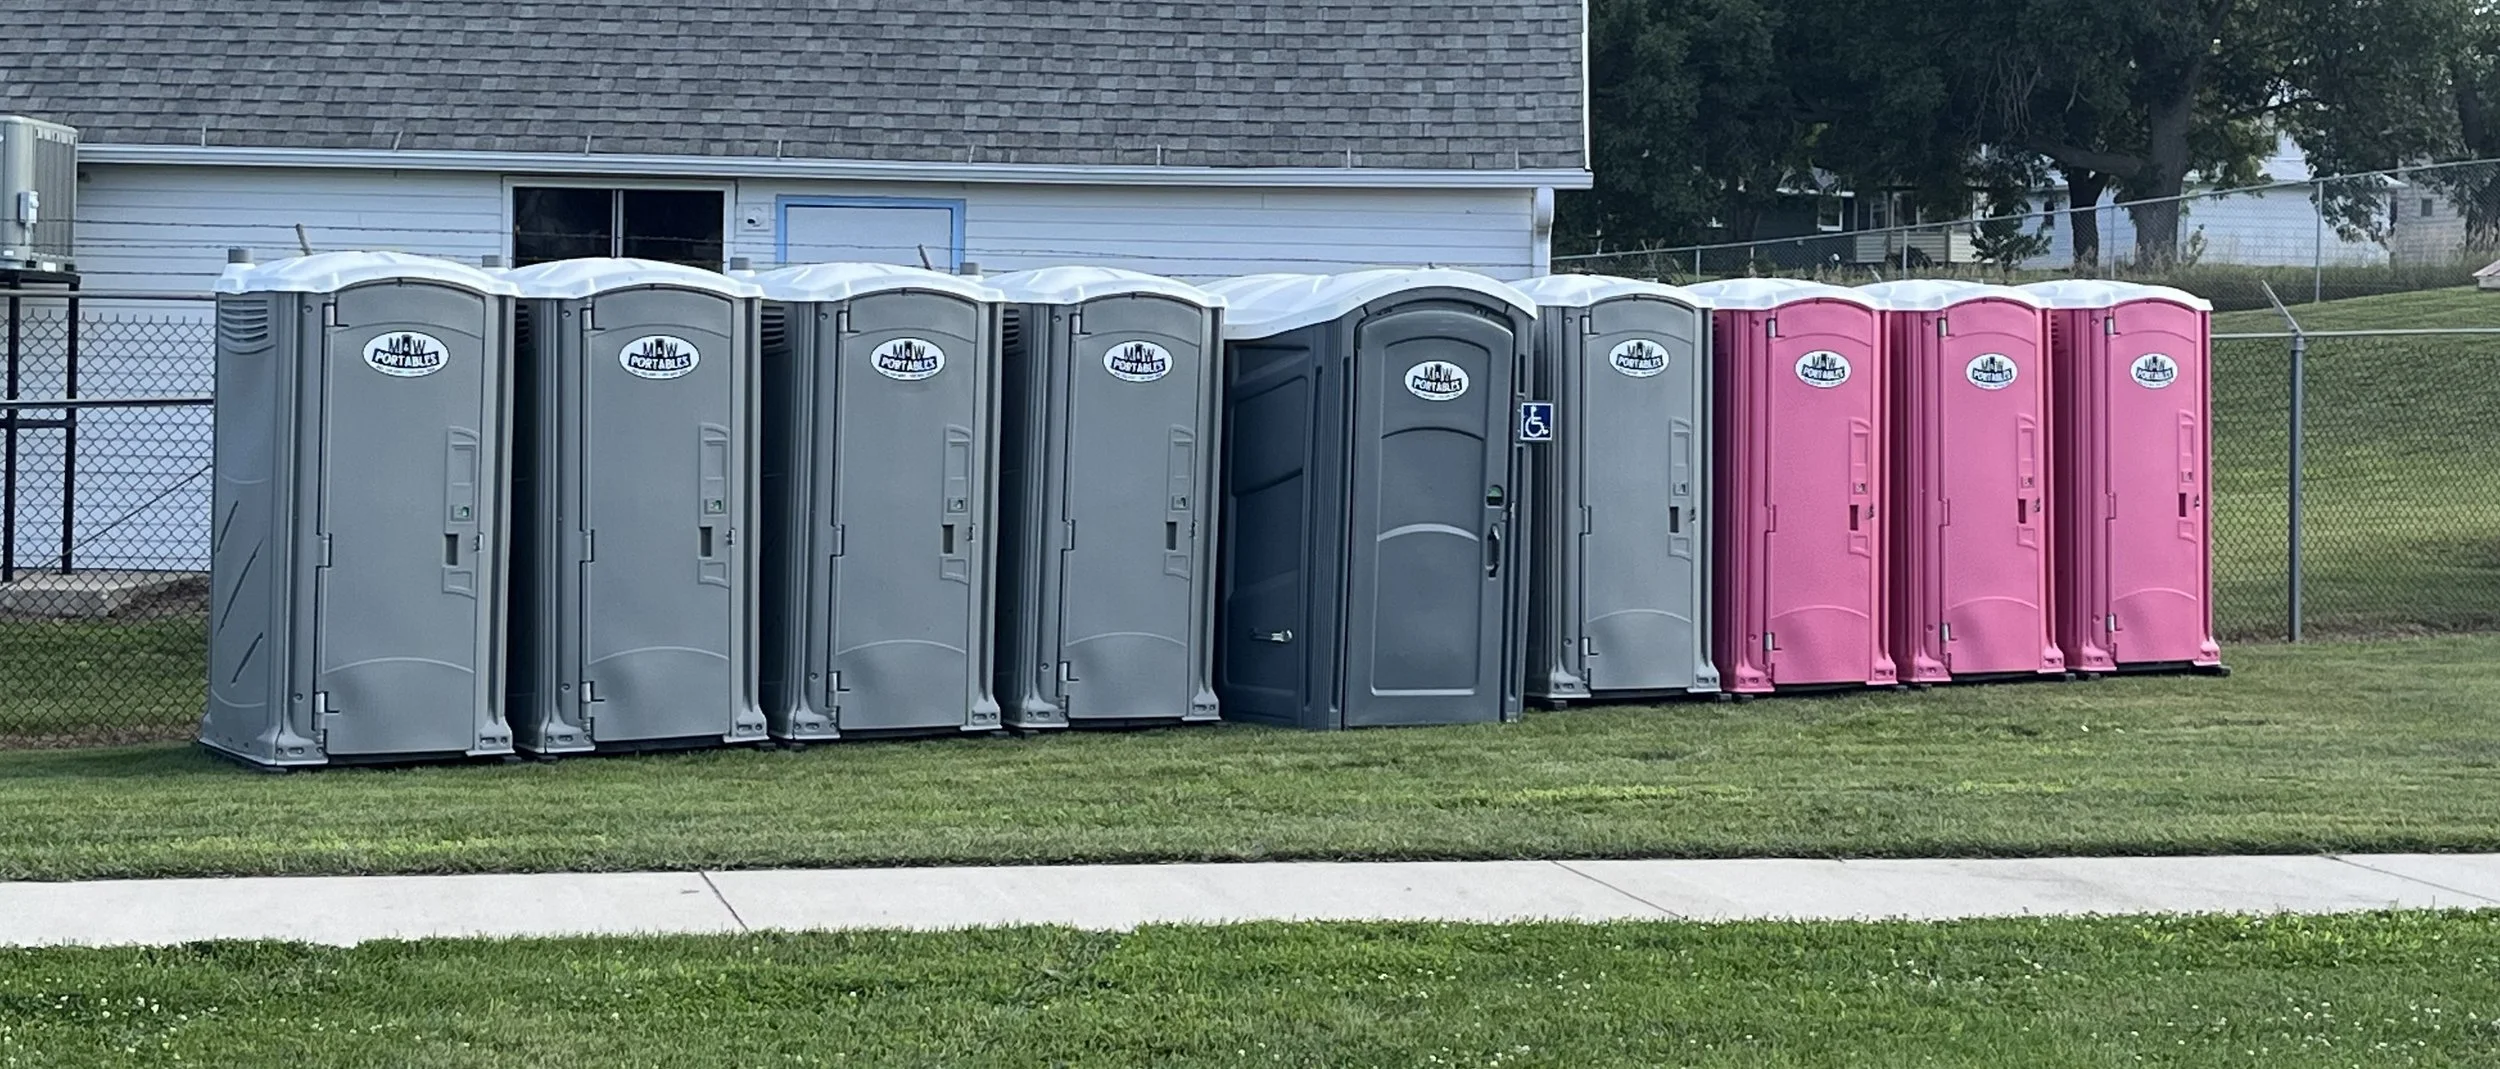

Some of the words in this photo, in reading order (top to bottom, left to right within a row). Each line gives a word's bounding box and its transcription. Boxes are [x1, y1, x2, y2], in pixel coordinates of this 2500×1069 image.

[376, 351, 437, 366] PORTABLES
[630, 355, 689, 369] PORTABLES
[881, 358, 936, 370] PORTABLES
[1618, 356, 1661, 368] PORTABLES
[1114, 358, 1164, 373] PORTABLES
[1804, 367, 1844, 379] PORTABLES
[1974, 369, 2011, 381] PORTABLES
[1414, 379, 1460, 391] PORTABLES
